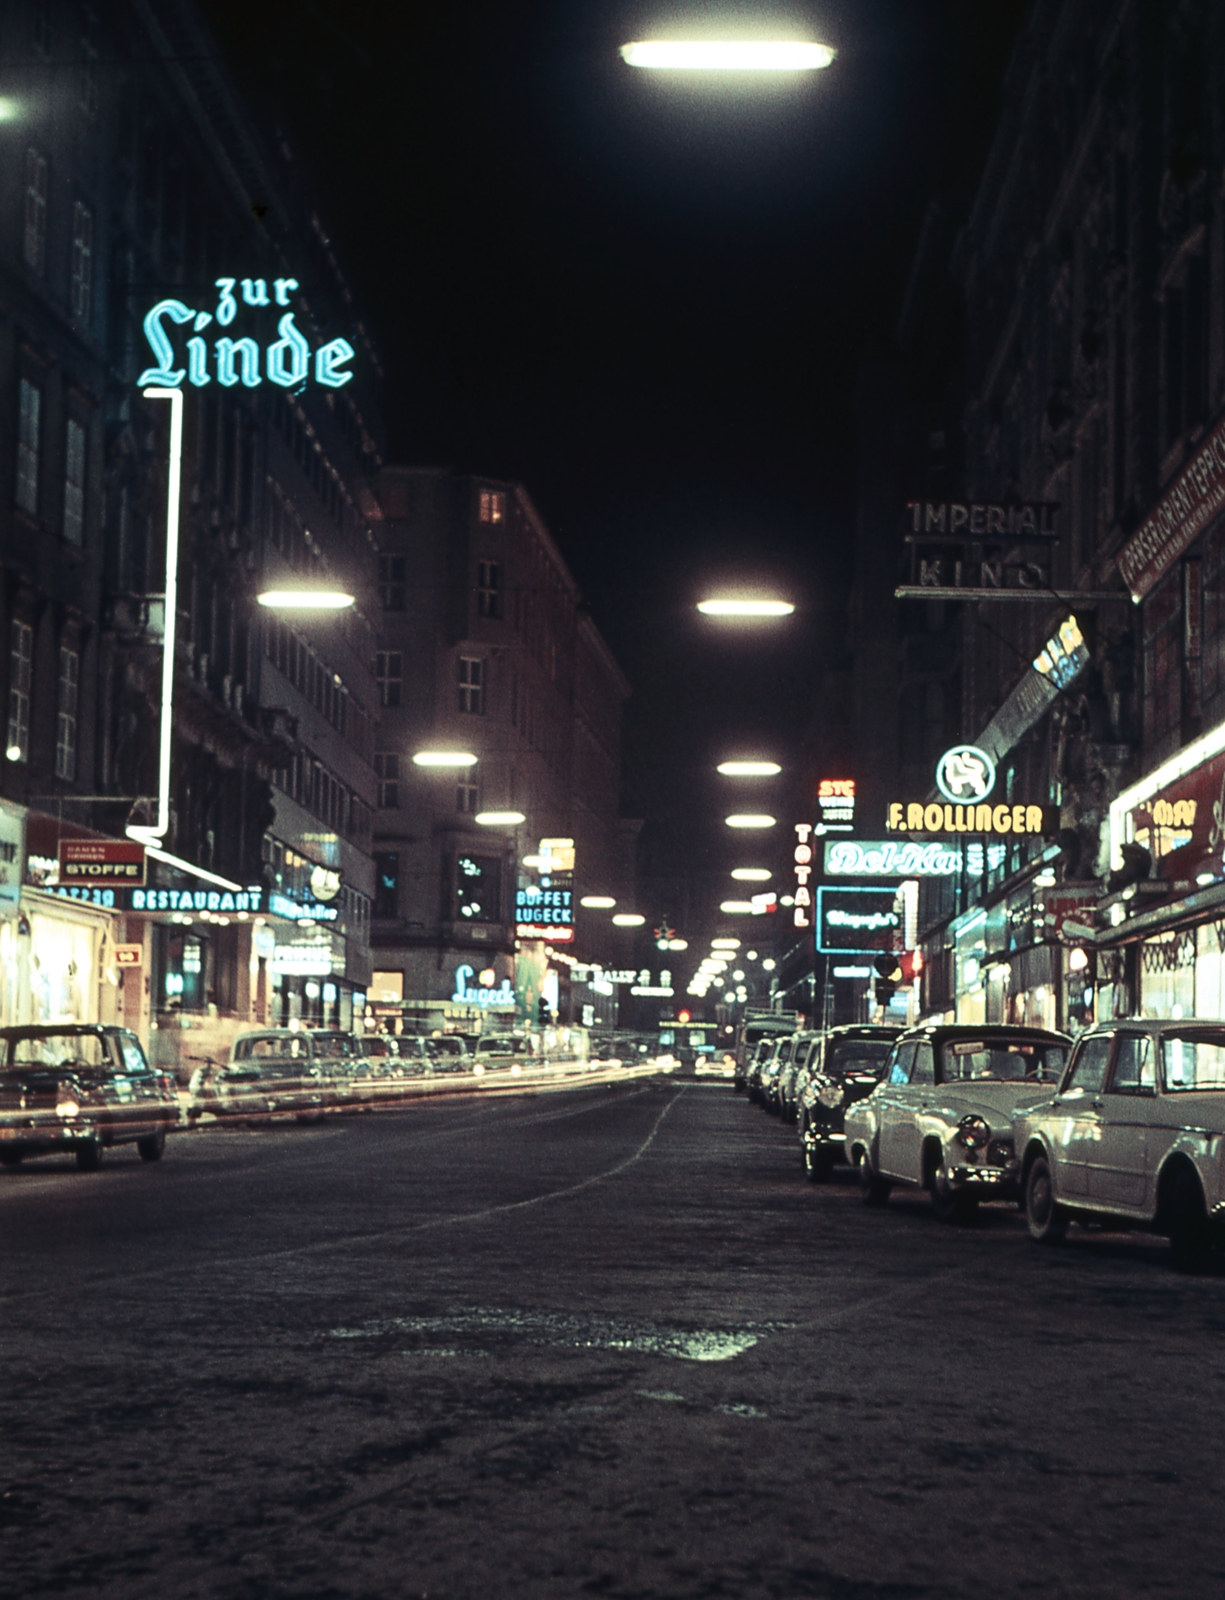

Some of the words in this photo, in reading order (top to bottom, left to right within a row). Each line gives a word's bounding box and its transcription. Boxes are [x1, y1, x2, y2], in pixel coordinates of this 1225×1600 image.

[214, 277, 299, 326] zur
[137, 299, 355, 388] Linde
[913, 503, 1055, 536] IMPERIAL
[920, 559, 1043, 589] KINO
[890, 802, 1043, 833] F.ROLLINGER
[66, 864, 138, 876] STOFFE
[794, 823, 812, 928] TOTAL
[132, 889, 262, 911] RESTAURANT
[516, 890, 571, 906] BUFFET
[515, 908, 572, 923] LUGECK
[451, 964, 516, 1009] Lugeck
